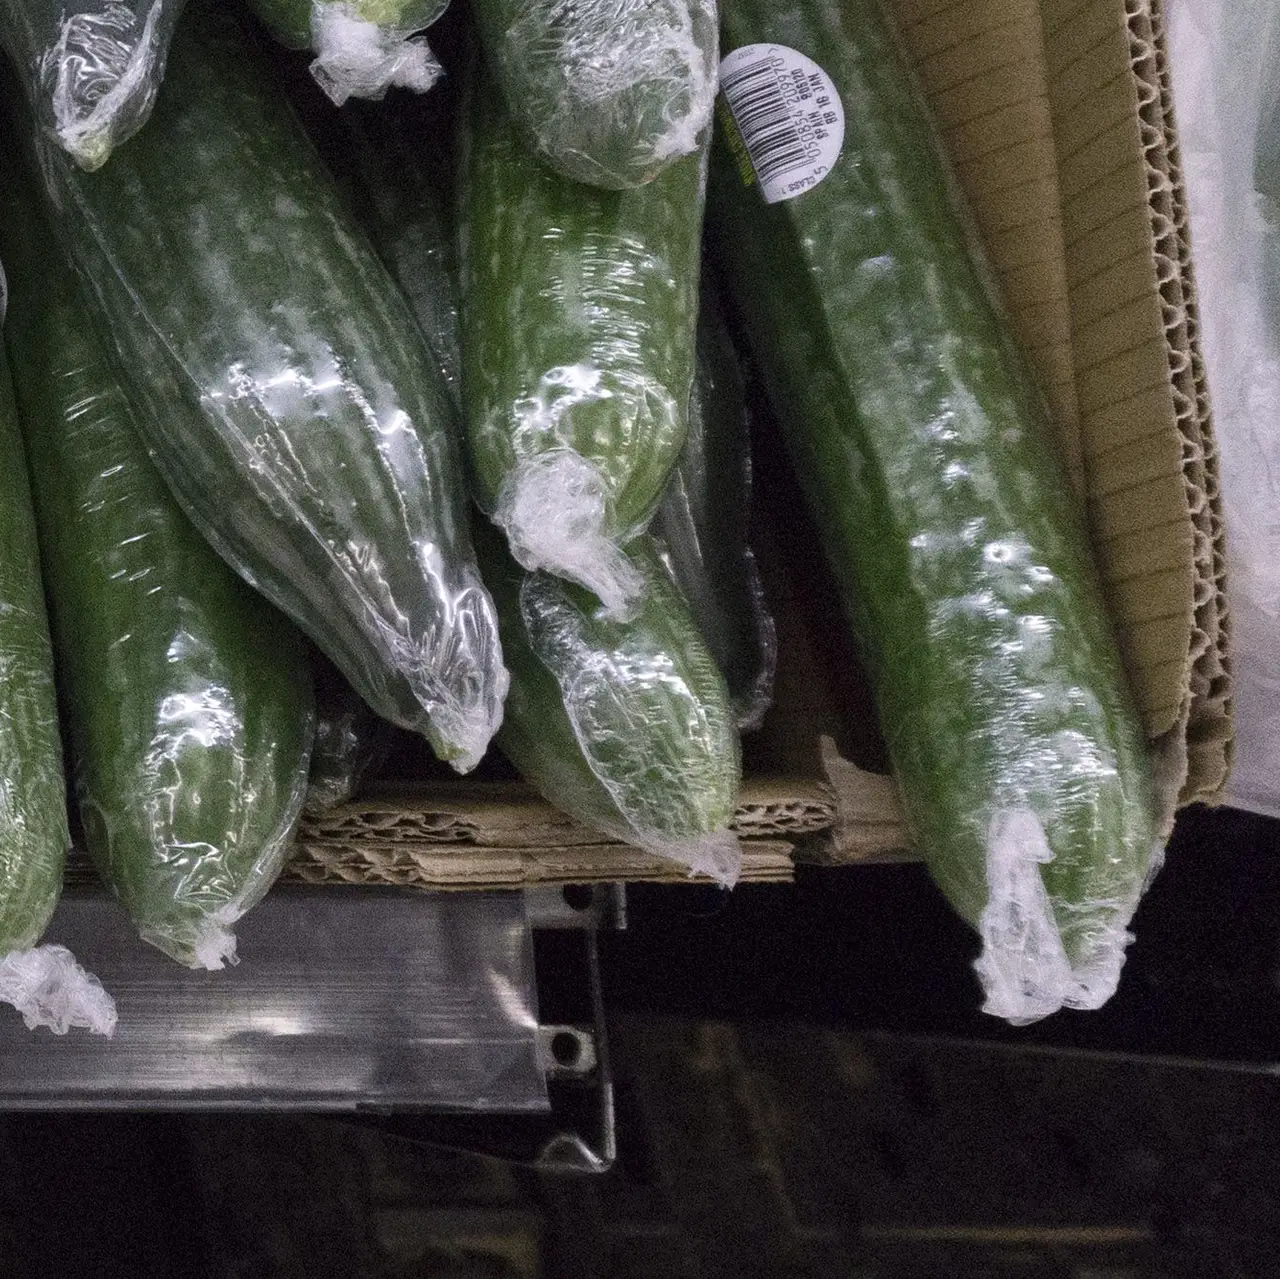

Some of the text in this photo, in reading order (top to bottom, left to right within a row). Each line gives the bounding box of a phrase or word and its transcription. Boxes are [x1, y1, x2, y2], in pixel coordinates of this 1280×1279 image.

[807, 72, 826, 93] JAN
[770, 56, 829, 175] 5 050854 209970
[807, 110, 830, 141] SPAIN
[822, 110, 838, 125] BB
[788, 175, 816, 192] CLASS
